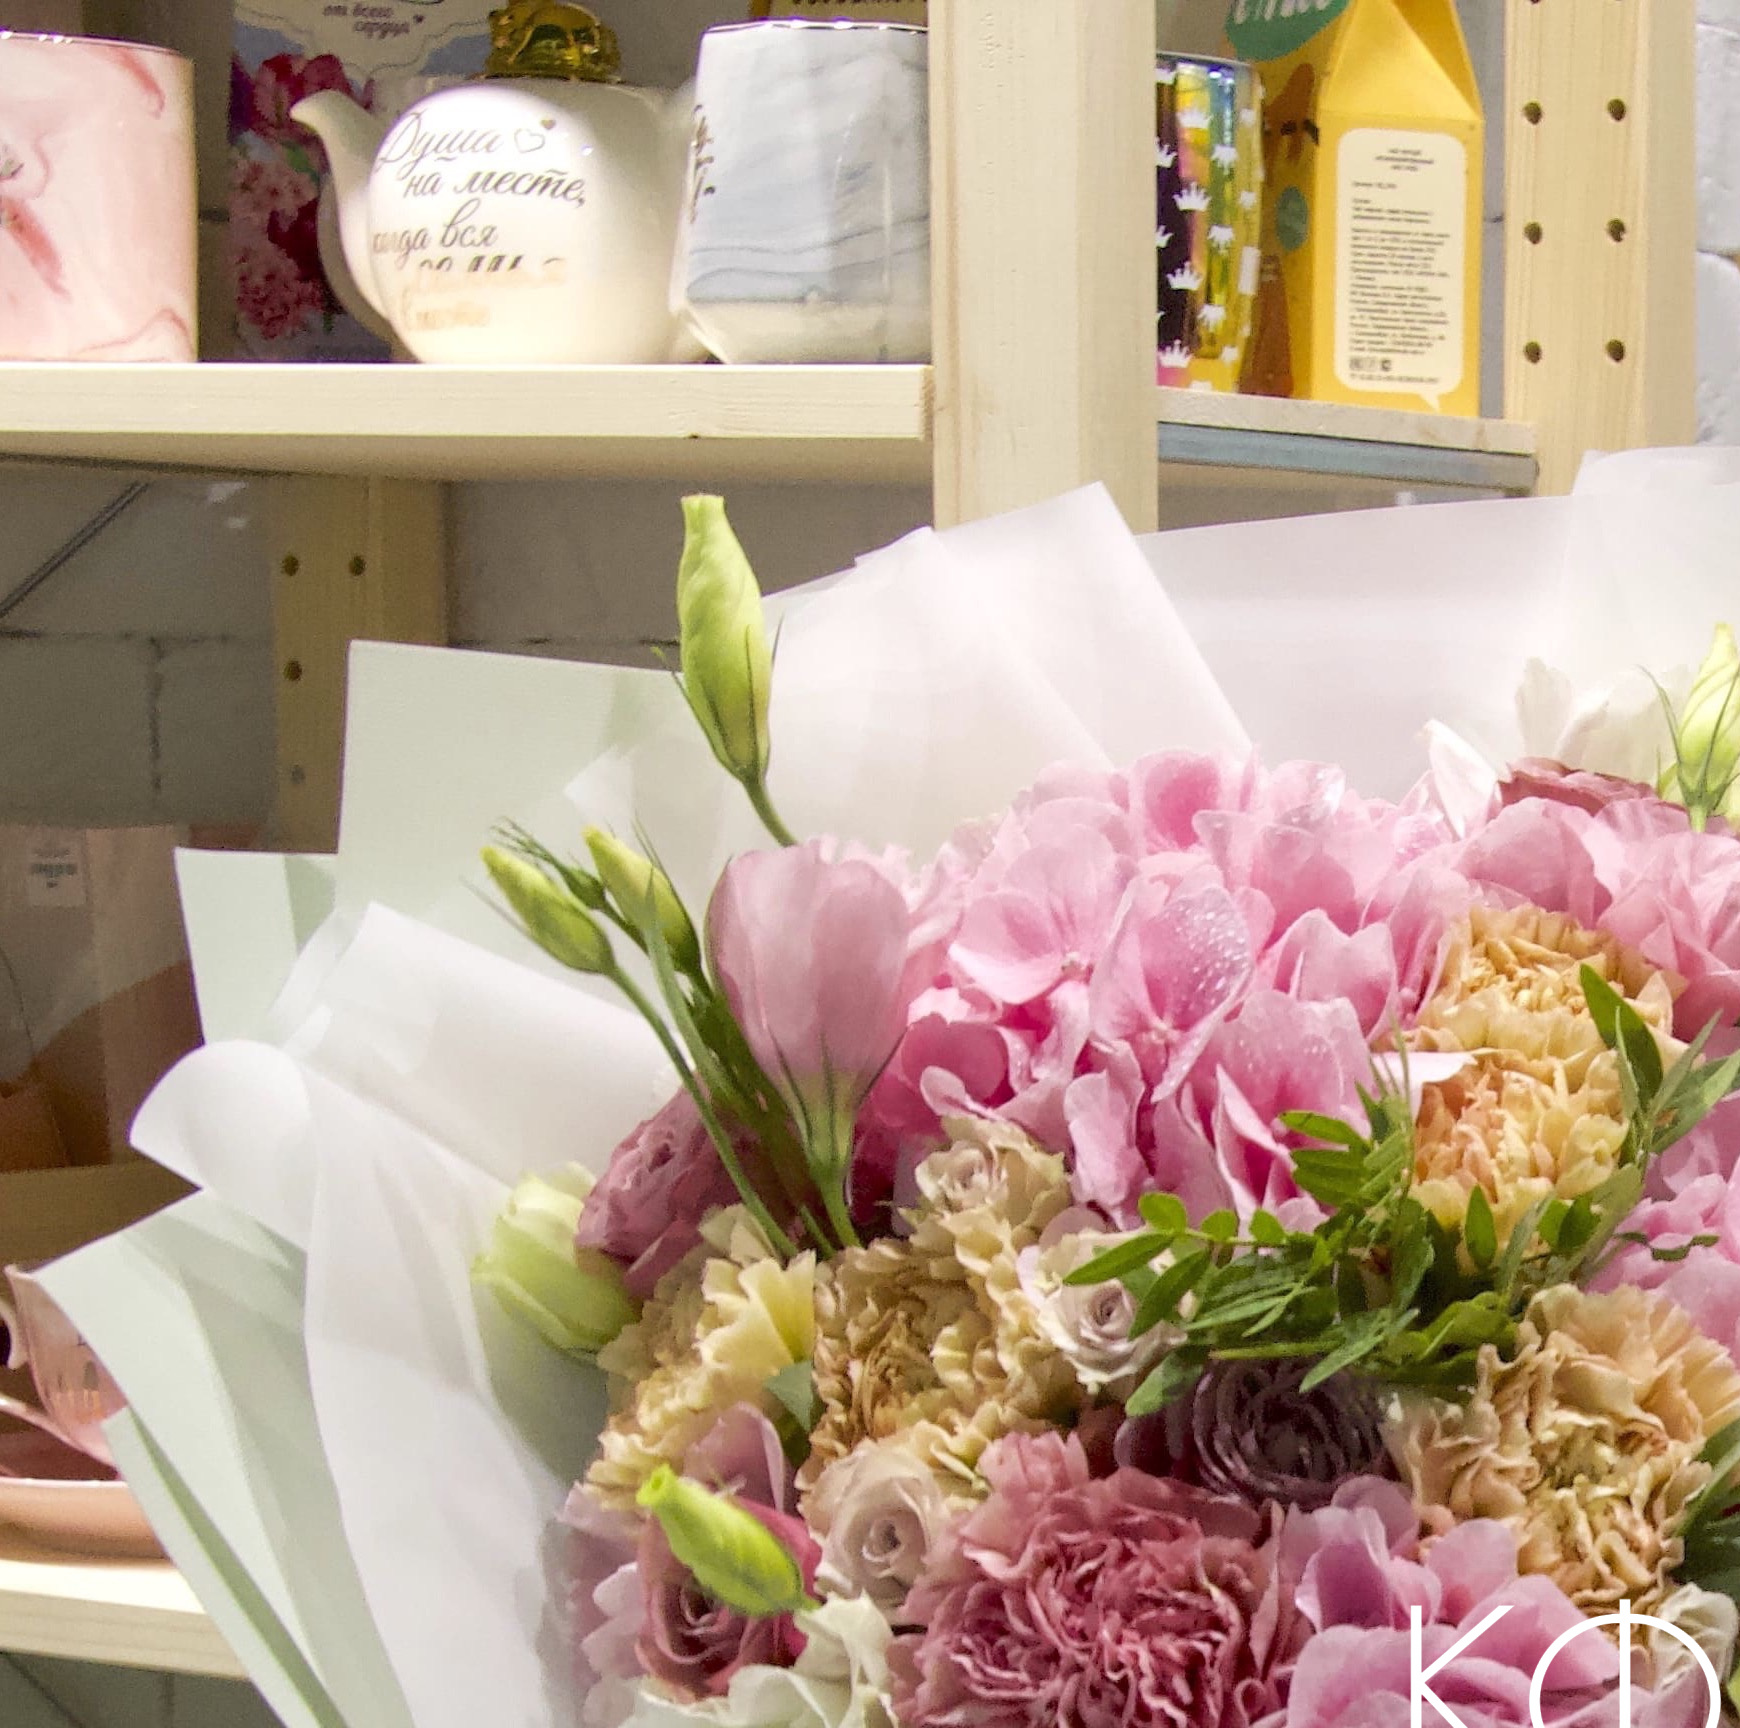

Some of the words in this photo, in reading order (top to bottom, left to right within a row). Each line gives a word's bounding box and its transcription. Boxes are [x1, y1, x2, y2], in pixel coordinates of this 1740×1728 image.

[375, 109, 503, 180] Душа
[403, 171, 443, 198] на
[440, 198, 499, 247] вся
